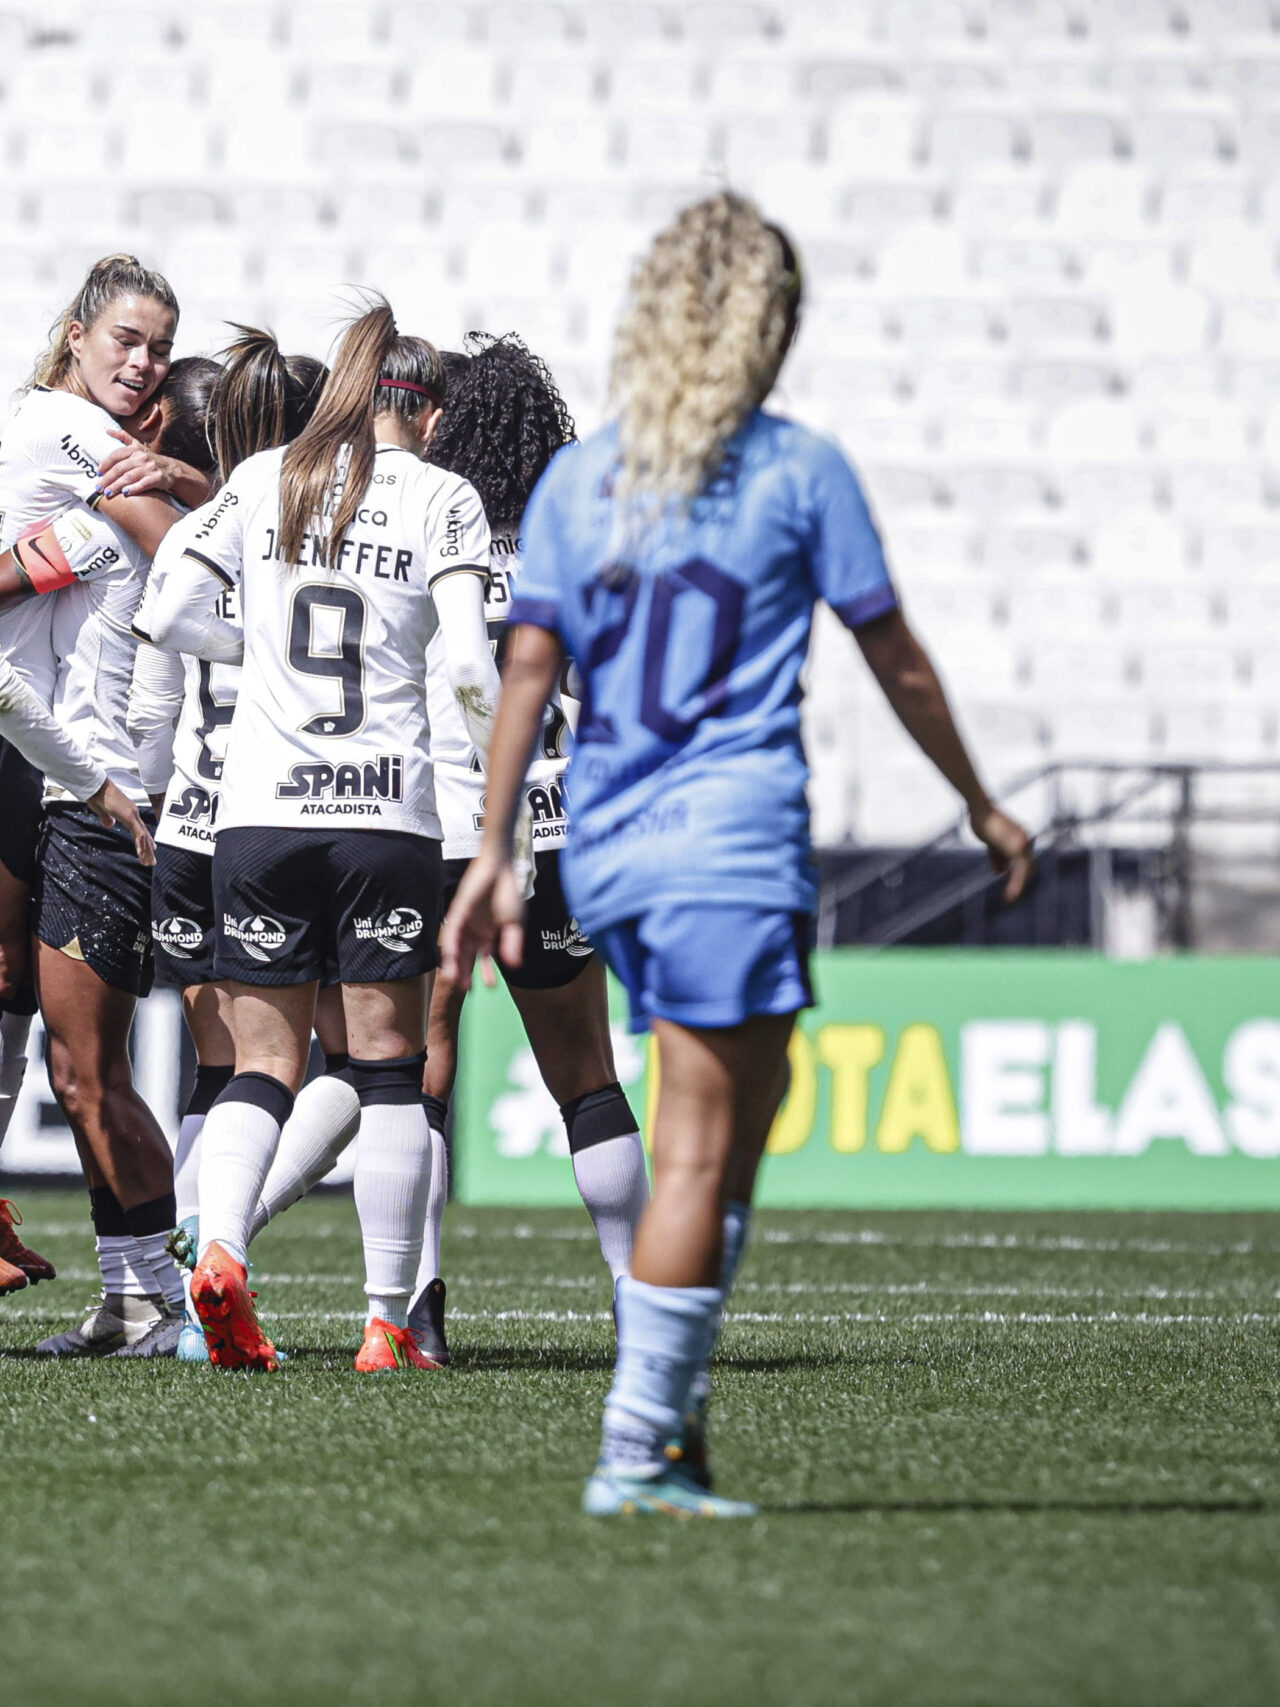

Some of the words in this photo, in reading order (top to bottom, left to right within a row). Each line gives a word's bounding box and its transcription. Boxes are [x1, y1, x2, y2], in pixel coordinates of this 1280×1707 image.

[202, 491, 239, 530] bmg
[261, 528, 413, 582] JENFFER
[286, 581, 368, 739] 9
[300, 803, 382, 815] ATACADISTA
[223, 913, 238, 928] Uni
[354, 917, 373, 929] Uni
[356, 919, 424, 940] DRUMMOND
[223, 925, 286, 943] DRUMMOND
[541, 930, 561, 941] Uni
[543, 929, 586, 950] DRUMMO
